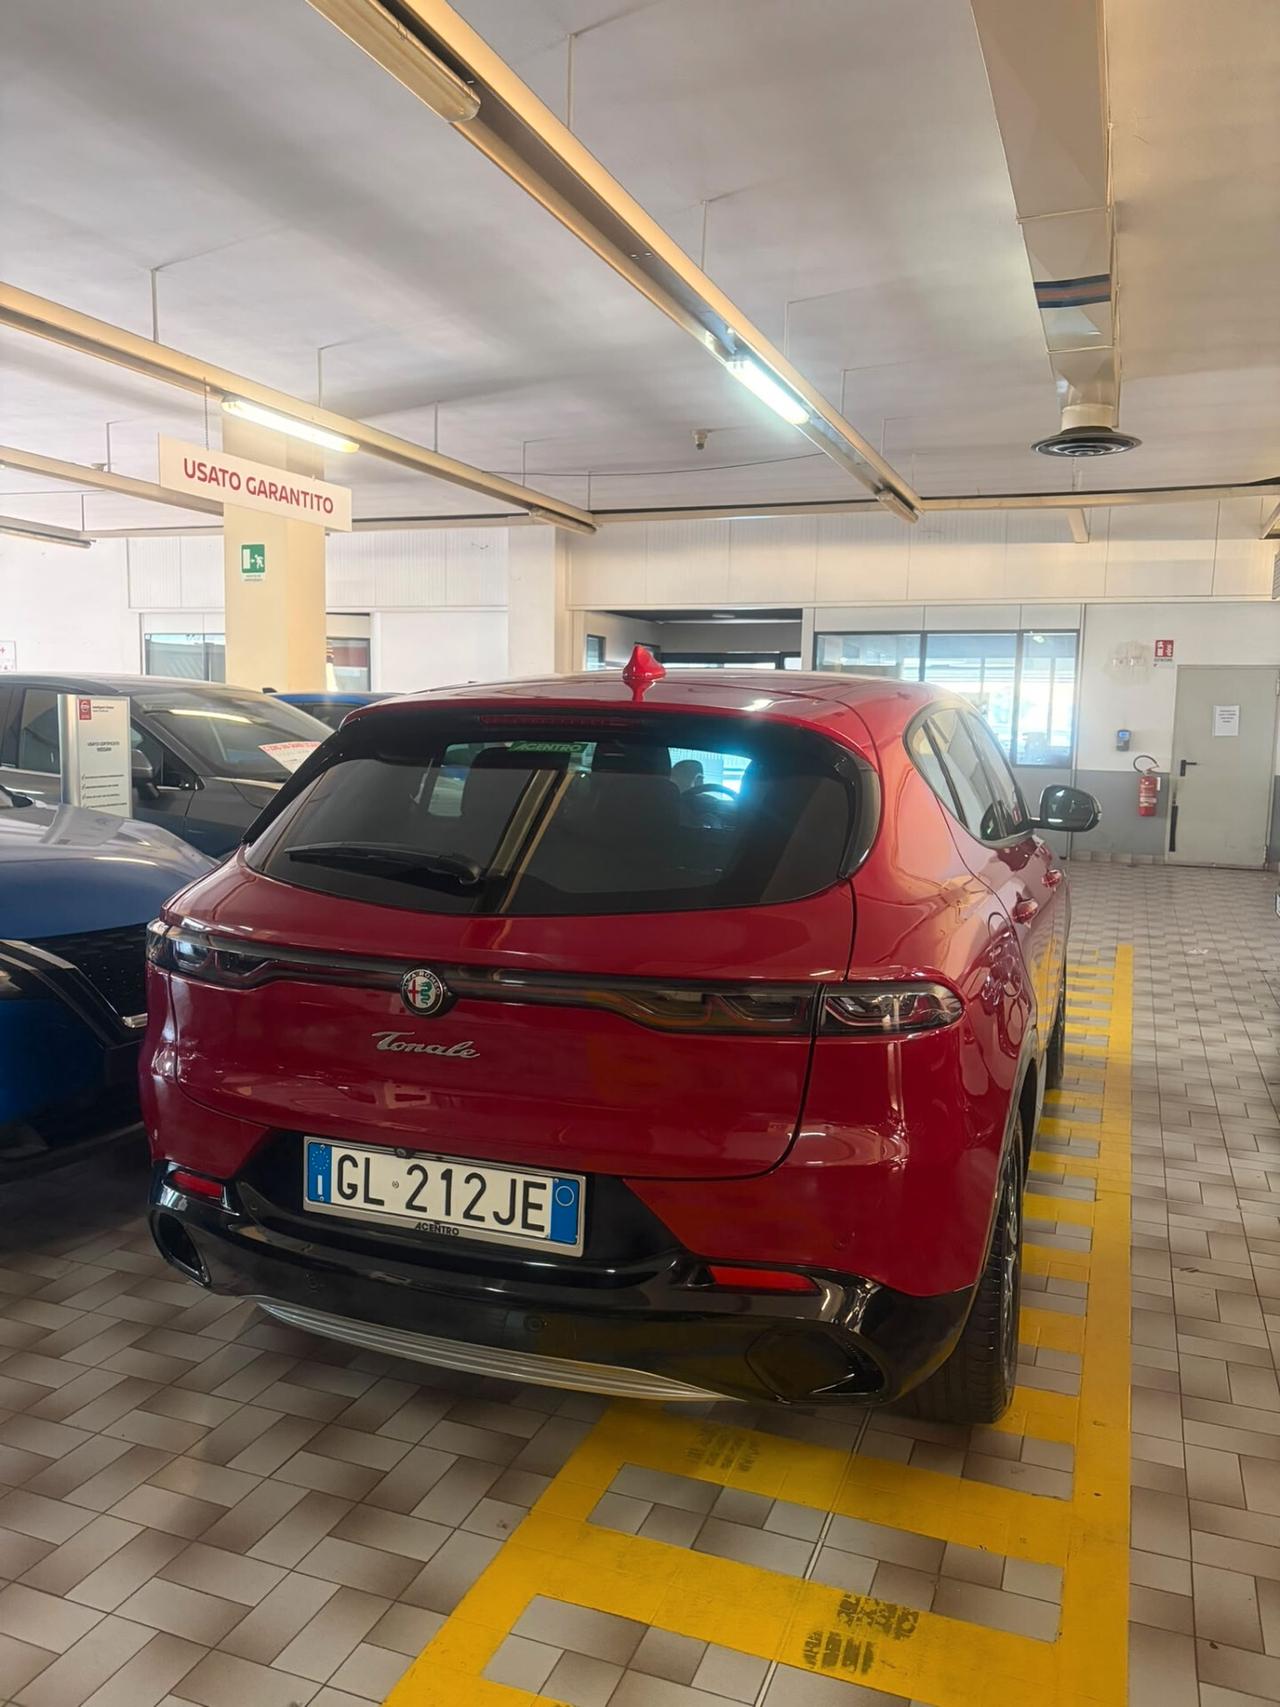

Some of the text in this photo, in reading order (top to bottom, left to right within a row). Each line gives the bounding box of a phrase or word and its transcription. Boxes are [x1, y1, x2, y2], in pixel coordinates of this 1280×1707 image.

[184, 458, 334, 514] USATO GARANTITO
[419, 971, 441, 994] ROMEO
[371, 1031, 481, 1059] Tonale
[337, 1154, 548, 1233] GL 212JE
